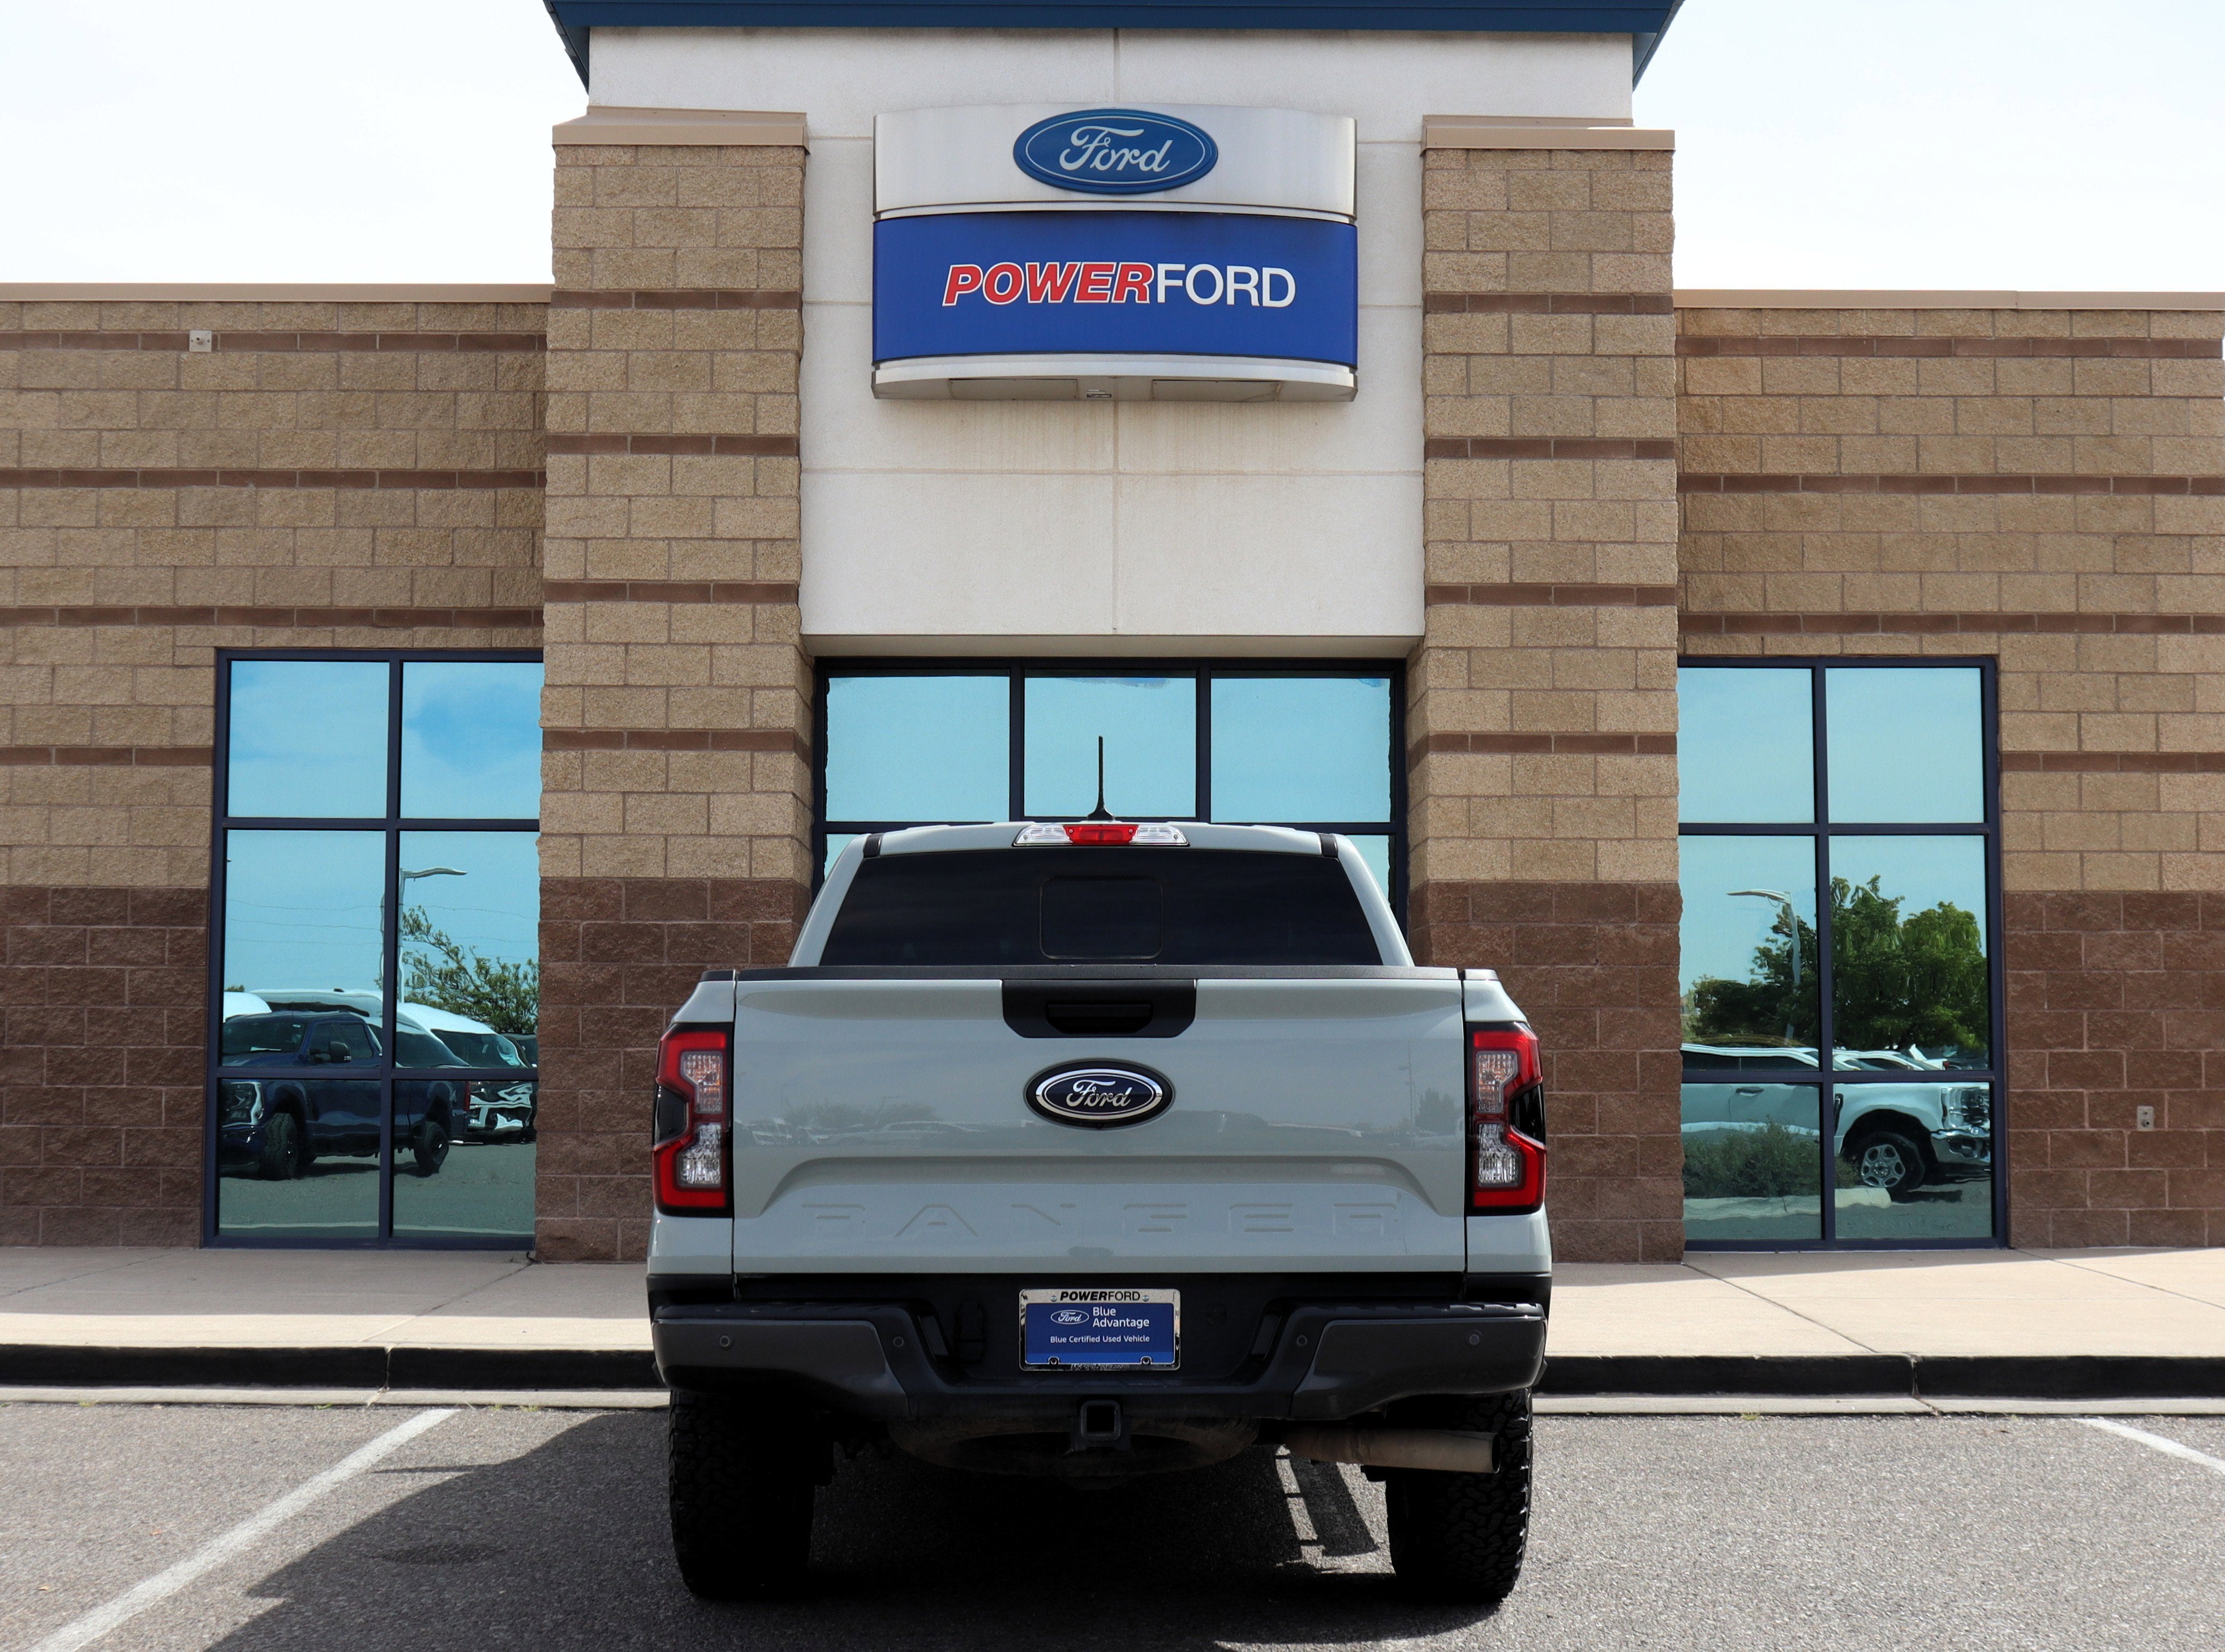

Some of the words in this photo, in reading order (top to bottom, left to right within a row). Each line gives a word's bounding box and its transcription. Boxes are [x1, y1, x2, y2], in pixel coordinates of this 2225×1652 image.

[1059, 125, 1173, 172] Ford
[1066, 1079, 1133, 1107] Ford
[801, 1203, 1397, 1237] RANGER
[1057, 1312, 1082, 1323] Ford
[1092, 1306, 1117, 1317] Blue
[1092, 1317, 1150, 1329] Advantage
[1069, 1335, 1100, 1343] Certified
[1124, 1334, 1150, 1342] Vehicle
